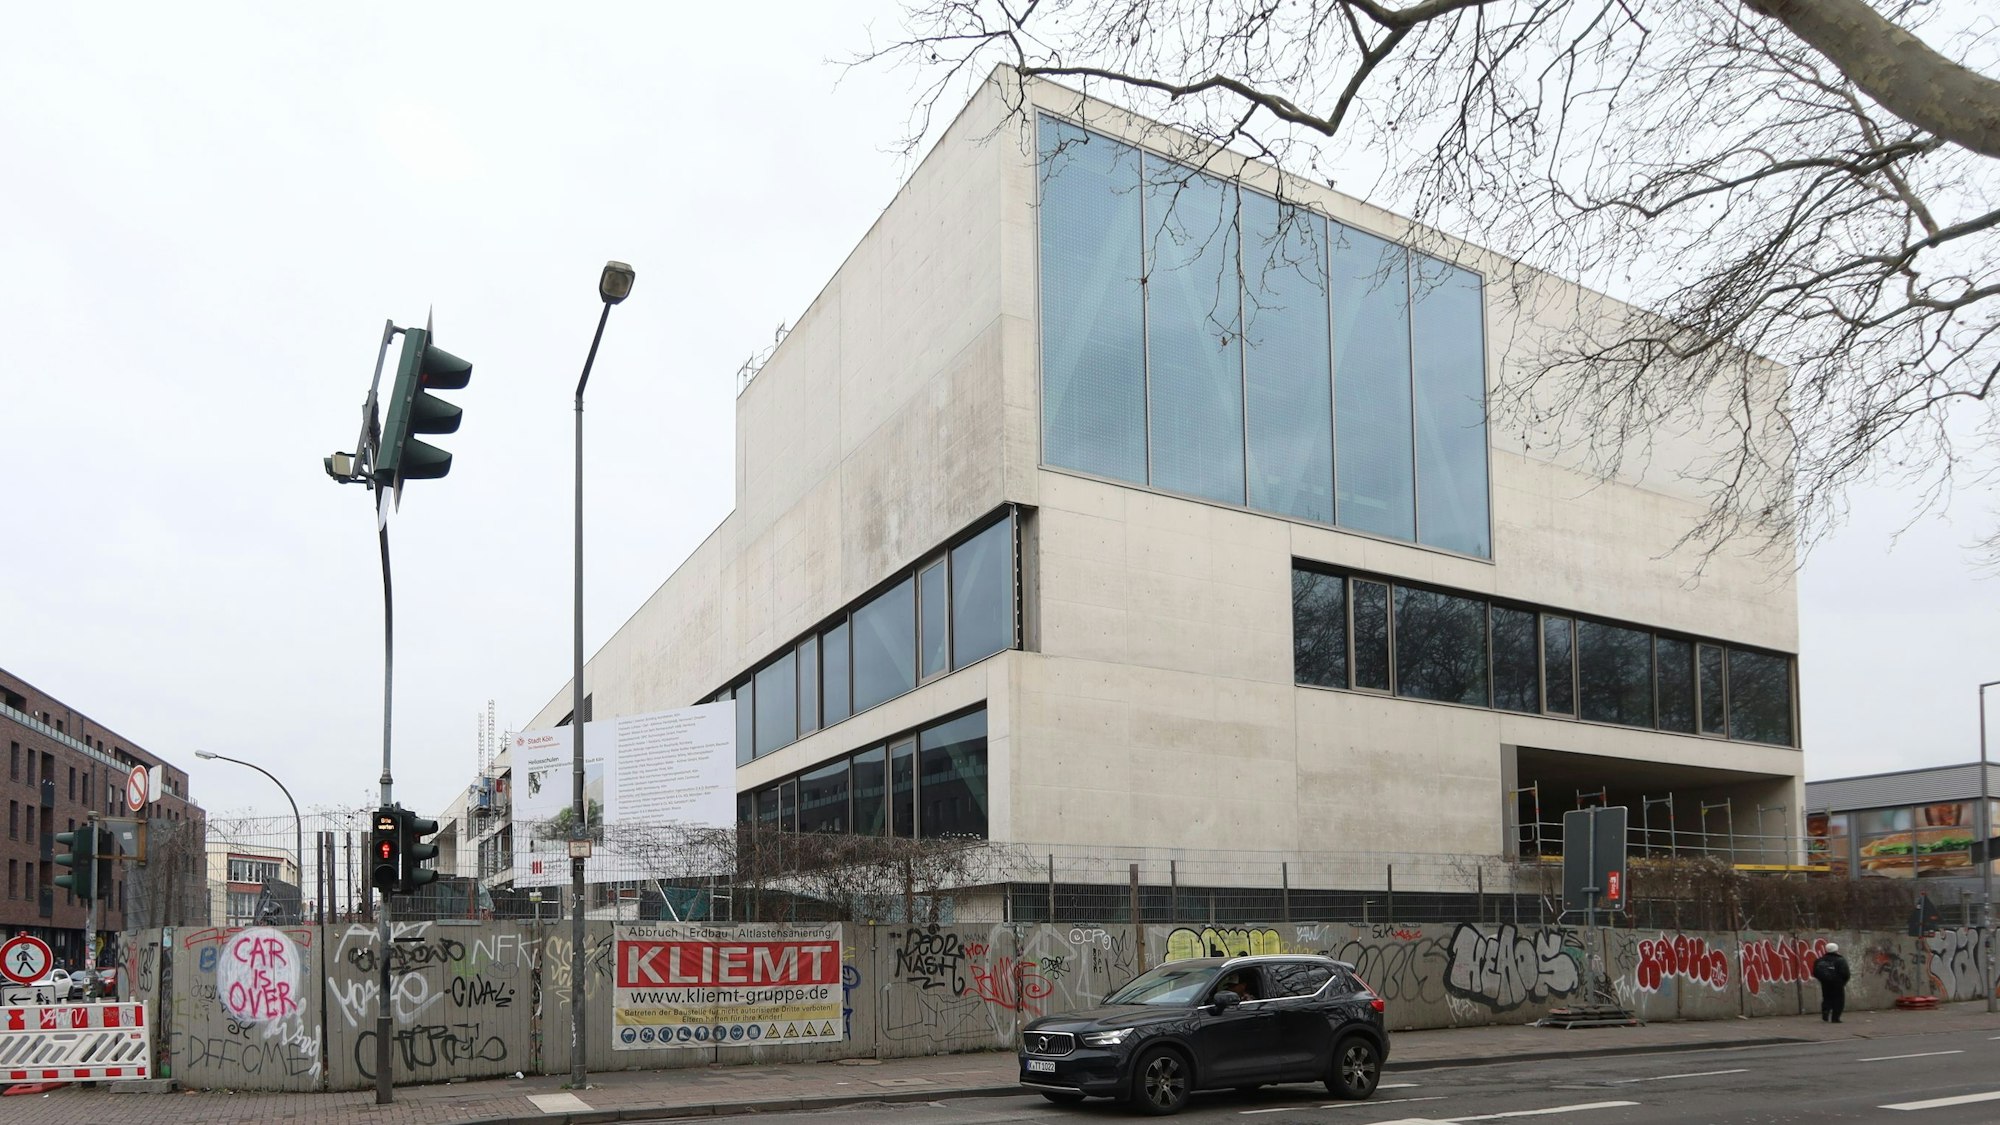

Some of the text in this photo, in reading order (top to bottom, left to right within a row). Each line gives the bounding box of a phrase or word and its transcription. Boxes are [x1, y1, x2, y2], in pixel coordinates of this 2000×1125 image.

[528, 735, 553, 745] Stadt Köln
[628, 926, 831, 939] Abbruch Erdbau Altlastensanierung
[234, 937, 287, 968] CAR
[627, 945, 832, 984] KLIEMT
[253, 969, 271, 989] IS
[229, 981, 297, 1019] OVER
[631, 985, 828, 1005] www.kliemt-gruppe.de
[624, 1009, 657, 1017] Betreten
[673, 1008, 707, 1016] Baustelle
[721, 1007, 738, 1015] nicht
[740, 1006, 780, 1014] autorisierte
[782, 1005, 800, 1013] Dritte
[801, 1004, 833, 1012] verboten!
[682, 1015, 703, 1023] Eltern
[758, 1013, 783, 1021] Kinder!
